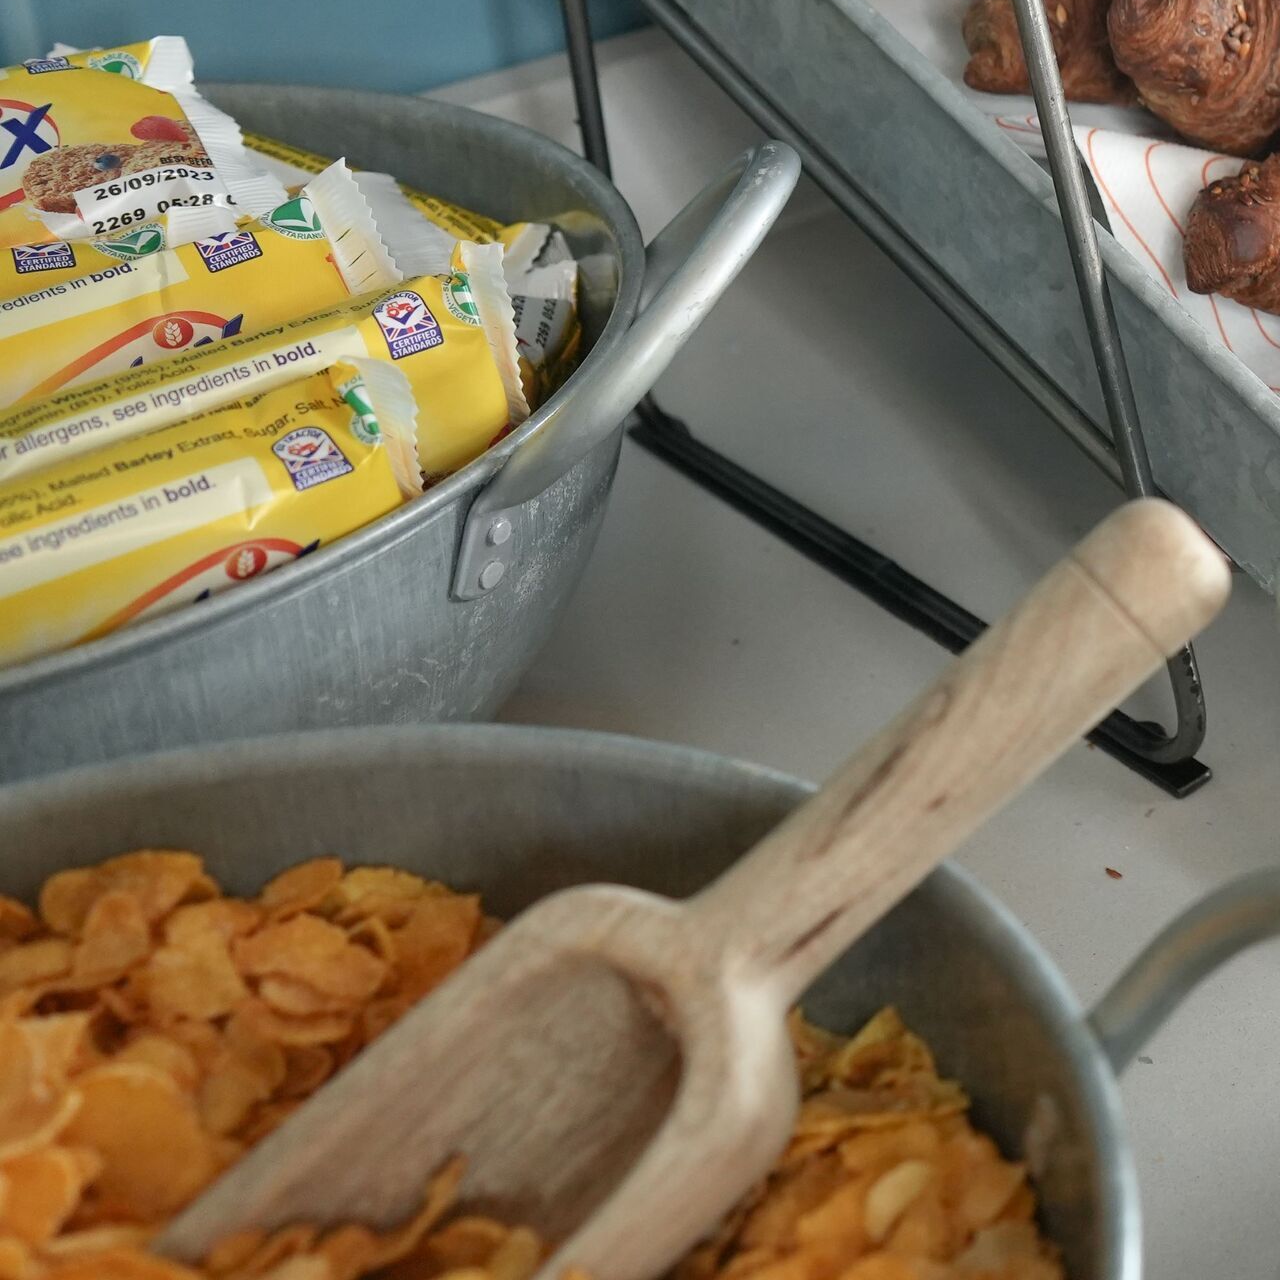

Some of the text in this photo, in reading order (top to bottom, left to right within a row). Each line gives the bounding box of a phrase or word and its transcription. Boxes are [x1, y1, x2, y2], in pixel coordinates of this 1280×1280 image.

[93, 168, 215, 201] 26/09/2023
[92, 208, 146, 235] 2269
[20, 256, 70, 266] CERTIFIED
[209, 243, 254, 264] CERTIFIED
[210, 248, 261, 271] STANDARDS
[18, 260, 74, 272] STANDARDS
[70, 277, 87, 291] in
[89, 262, 138, 283] bold.
[231, 326, 284, 347] Barley
[392, 329, 437, 350] CERTIFIED
[392, 335, 442, 358] STANDARDS
[14, 413, 110, 456] allergens,
[112, 400, 148, 421] see
[150, 363, 251, 407] ingredients
[252, 356, 271, 375] in
[273, 341, 322, 367] bold.
[243, 413, 296, 438] Sugar,
[295, 398, 333, 416] Salt,
[27, 503, 139, 550] ingredients
[140, 494, 162, 512] in
[162, 476, 217, 502] bold.
